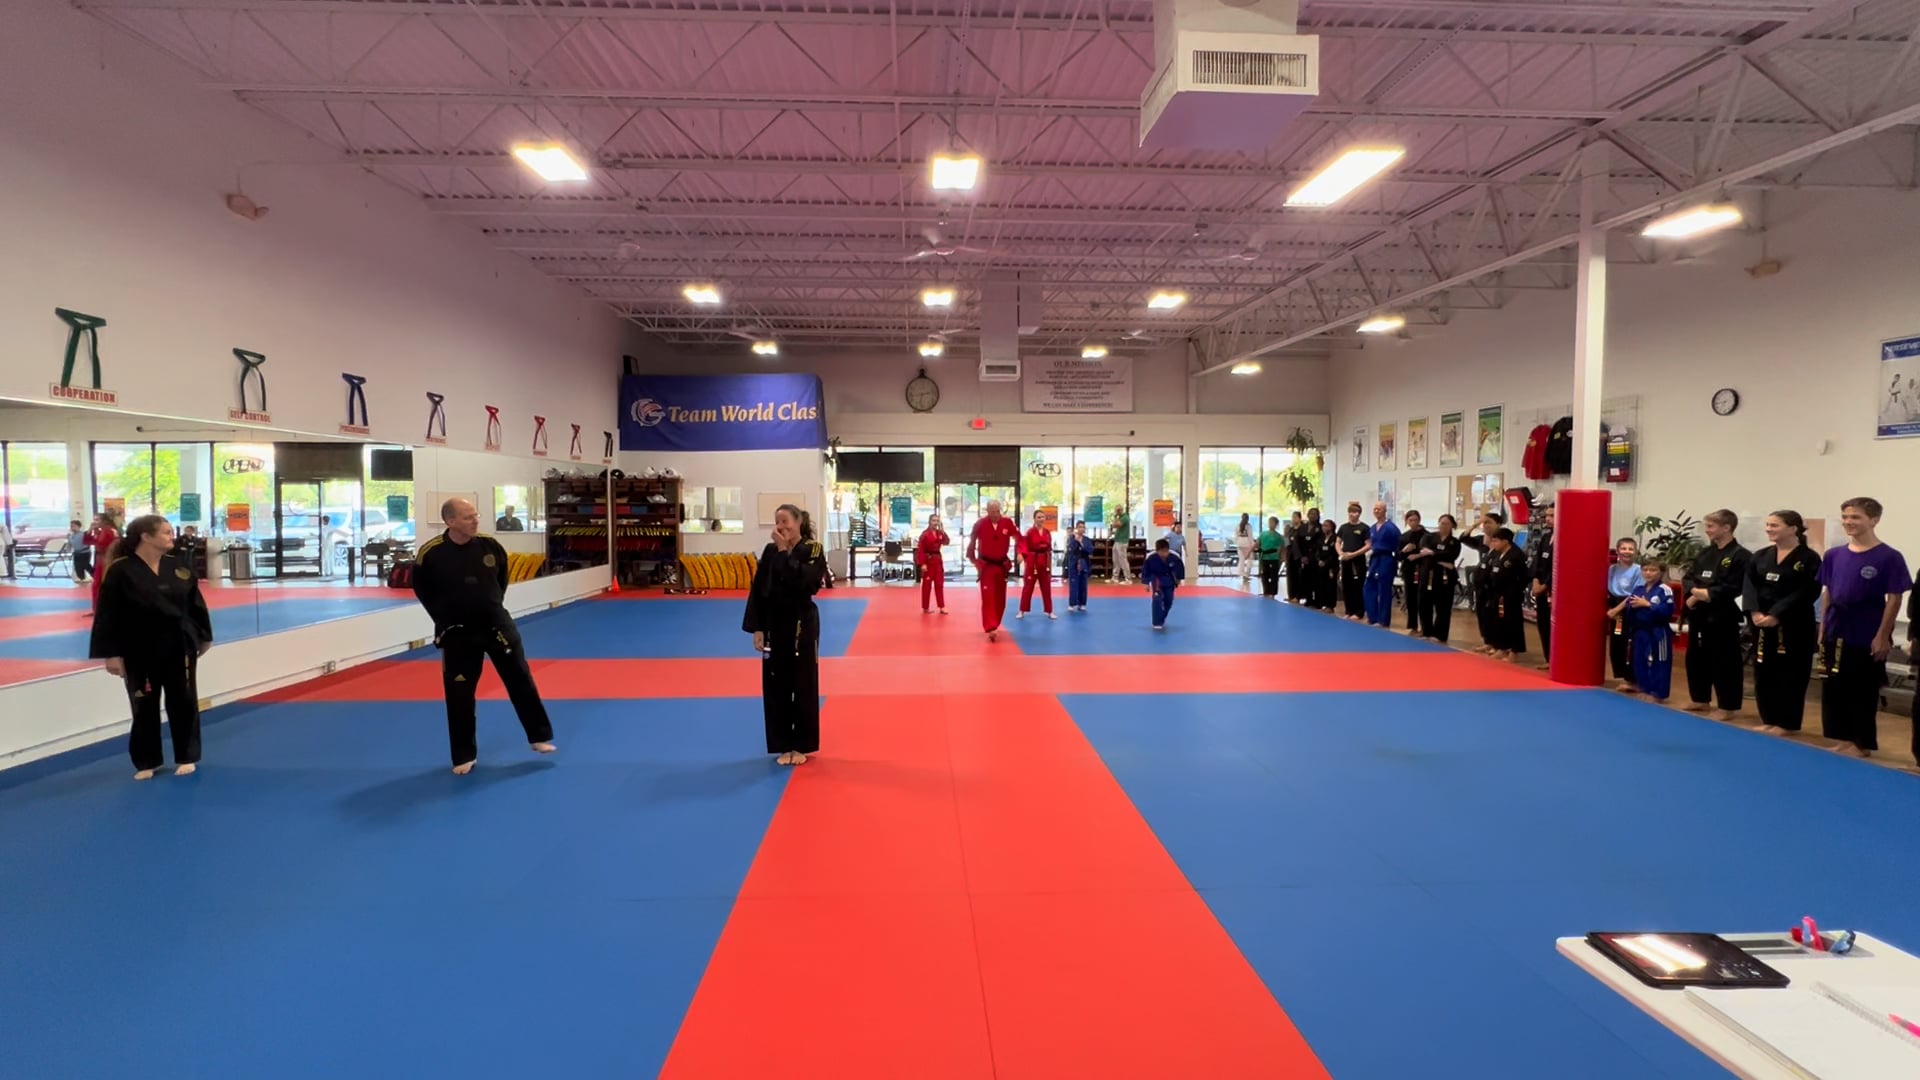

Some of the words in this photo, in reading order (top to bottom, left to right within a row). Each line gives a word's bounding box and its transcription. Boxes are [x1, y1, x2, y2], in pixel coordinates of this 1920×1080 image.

[53, 385, 115, 403] COOPERATION
[668, 406, 717, 423] Team
[721, 402, 774, 423] World
[777, 401, 817, 421] Clas
